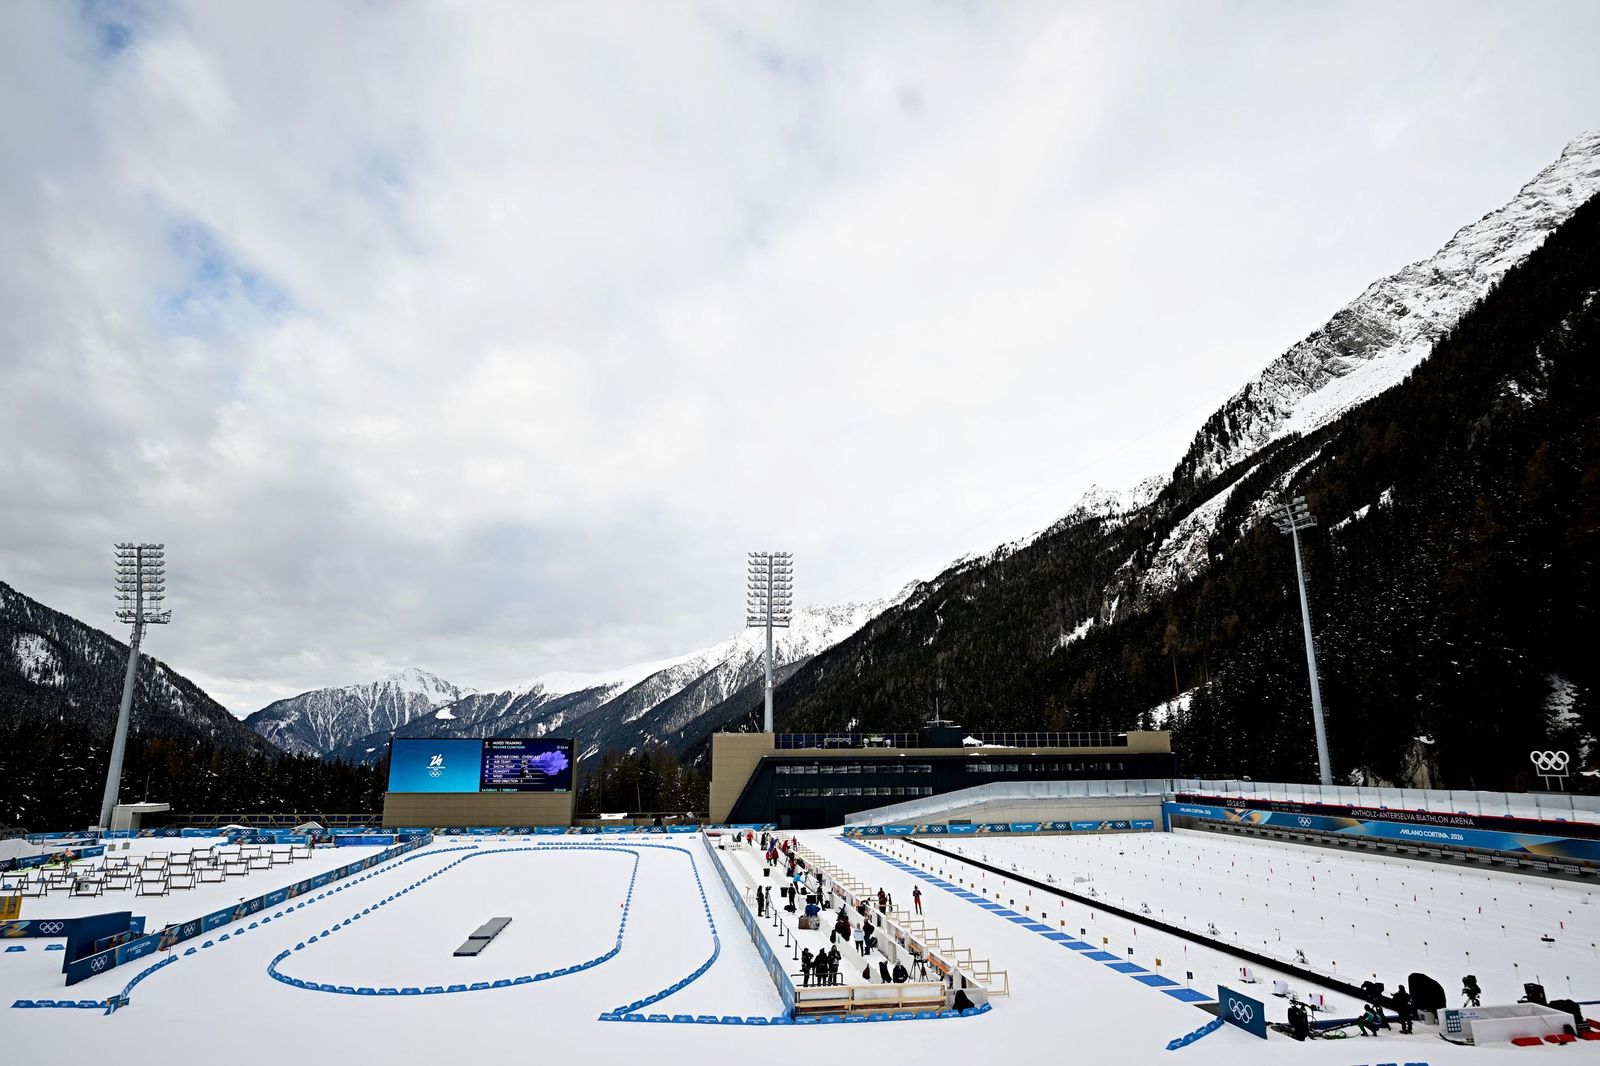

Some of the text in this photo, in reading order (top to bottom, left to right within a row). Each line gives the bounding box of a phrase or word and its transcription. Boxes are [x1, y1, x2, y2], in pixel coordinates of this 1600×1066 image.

[1351, 809, 1475, 825] ANTHOLZ-ANTERSELVA BIATHLON ARENA
[1400, 828, 1464, 841] MILANO CORTINA 2026
